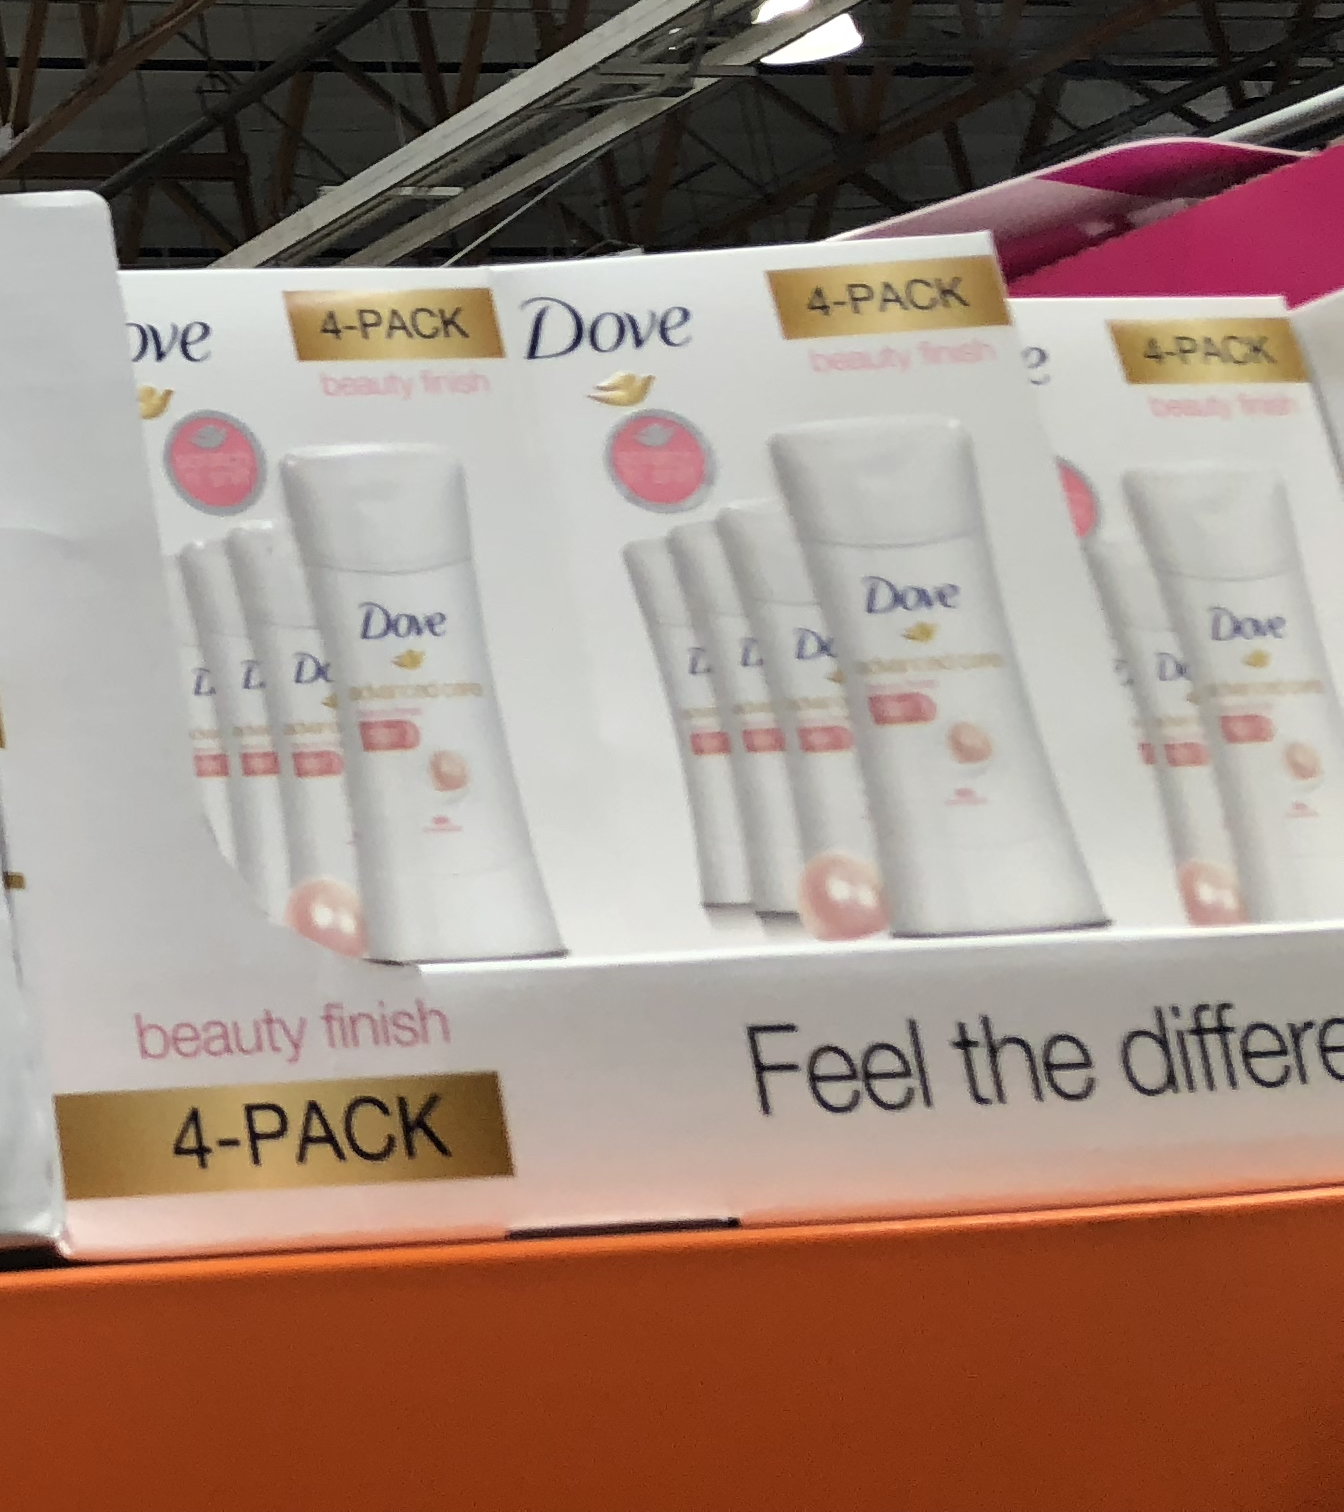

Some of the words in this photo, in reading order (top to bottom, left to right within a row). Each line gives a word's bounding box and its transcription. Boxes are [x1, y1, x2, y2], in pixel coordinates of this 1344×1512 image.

[807, 276, 970, 317] 4-PACK
[320, 307, 469, 340] 4-PACK
[519, 296, 692, 360] Dove
[862, 575, 960, 614] Dove
[358, 601, 447, 641] Dove
[134, 1008, 308, 1064] beauty
[320, 998, 451, 1050] finish
[746, 1017, 934, 1117] Feel
[951, 1013, 1097, 1106] the
[172, 1093, 453, 1170] 4-PACK
